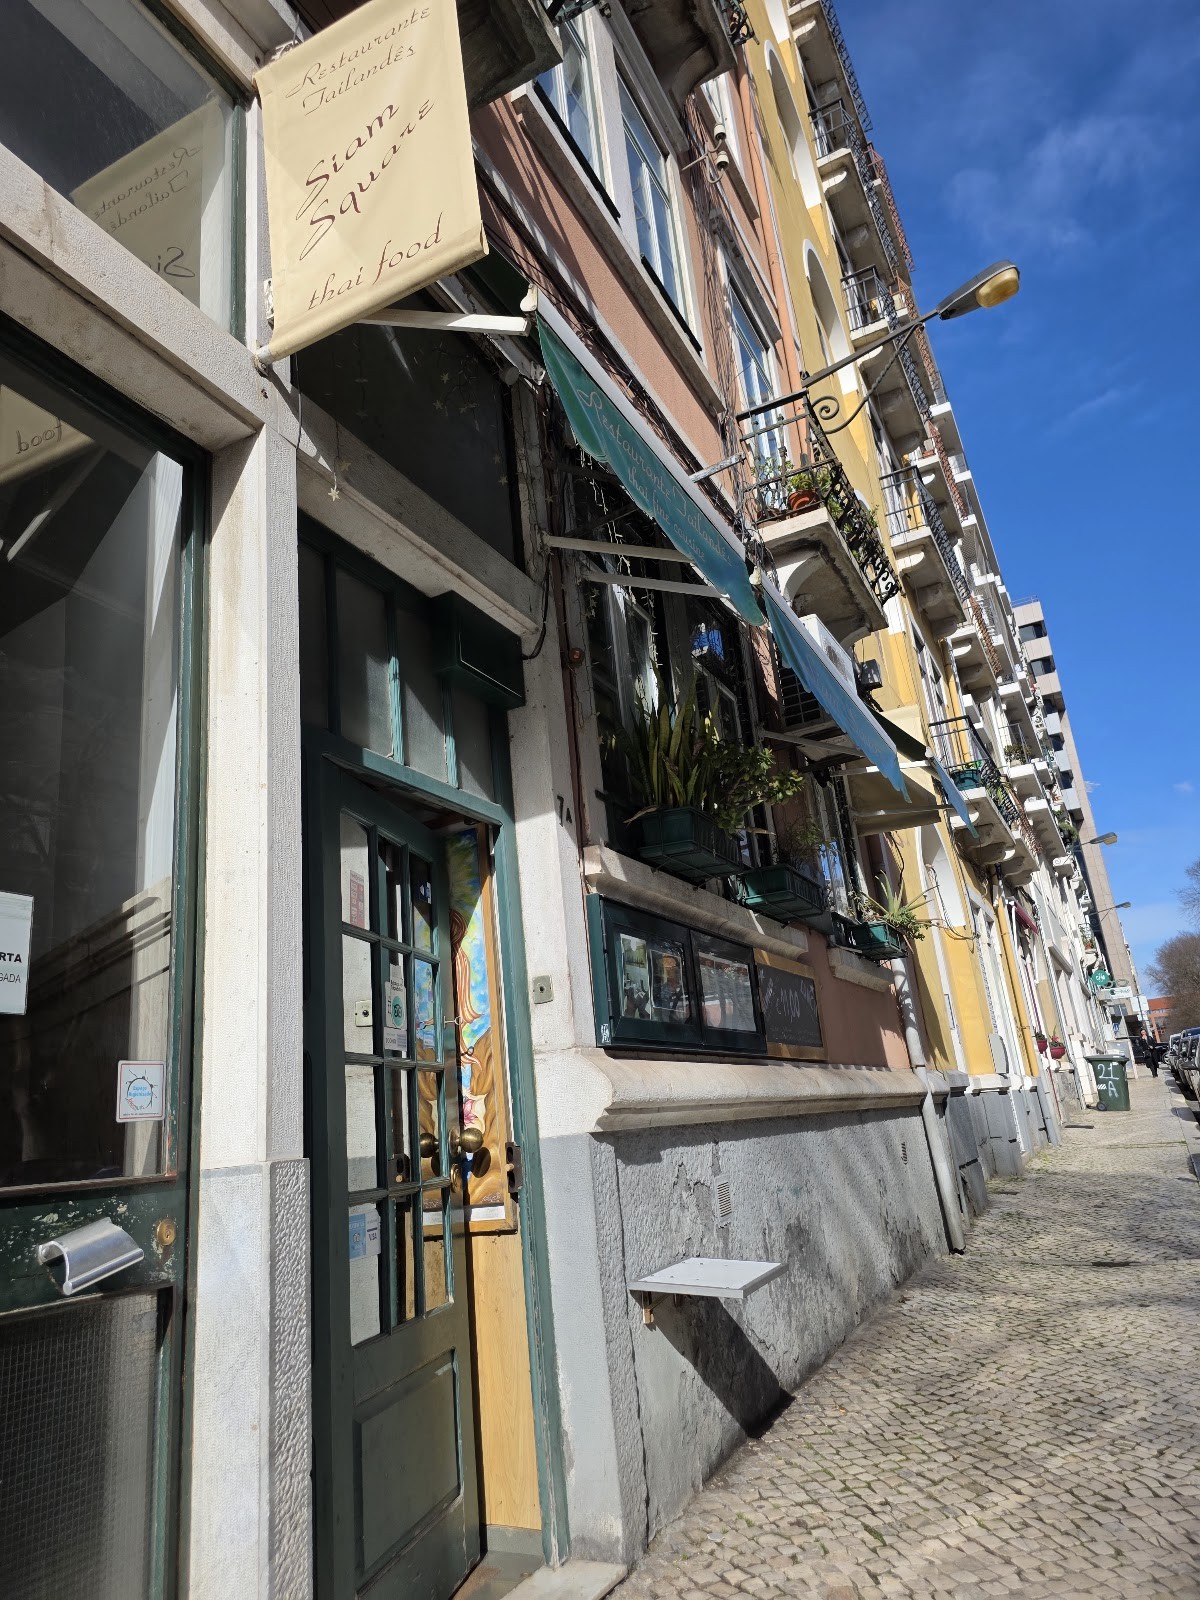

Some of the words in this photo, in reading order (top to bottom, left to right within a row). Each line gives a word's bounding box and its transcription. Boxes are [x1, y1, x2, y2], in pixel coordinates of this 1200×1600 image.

[285, 7, 432, 99] Restaurante
[302, 44, 416, 116] Tailandês
[295, 103, 399, 221] Siam
[299, 98, 435, 261] Square
[307, 266, 364, 311] thai
[371, 211, 443, 285] food
